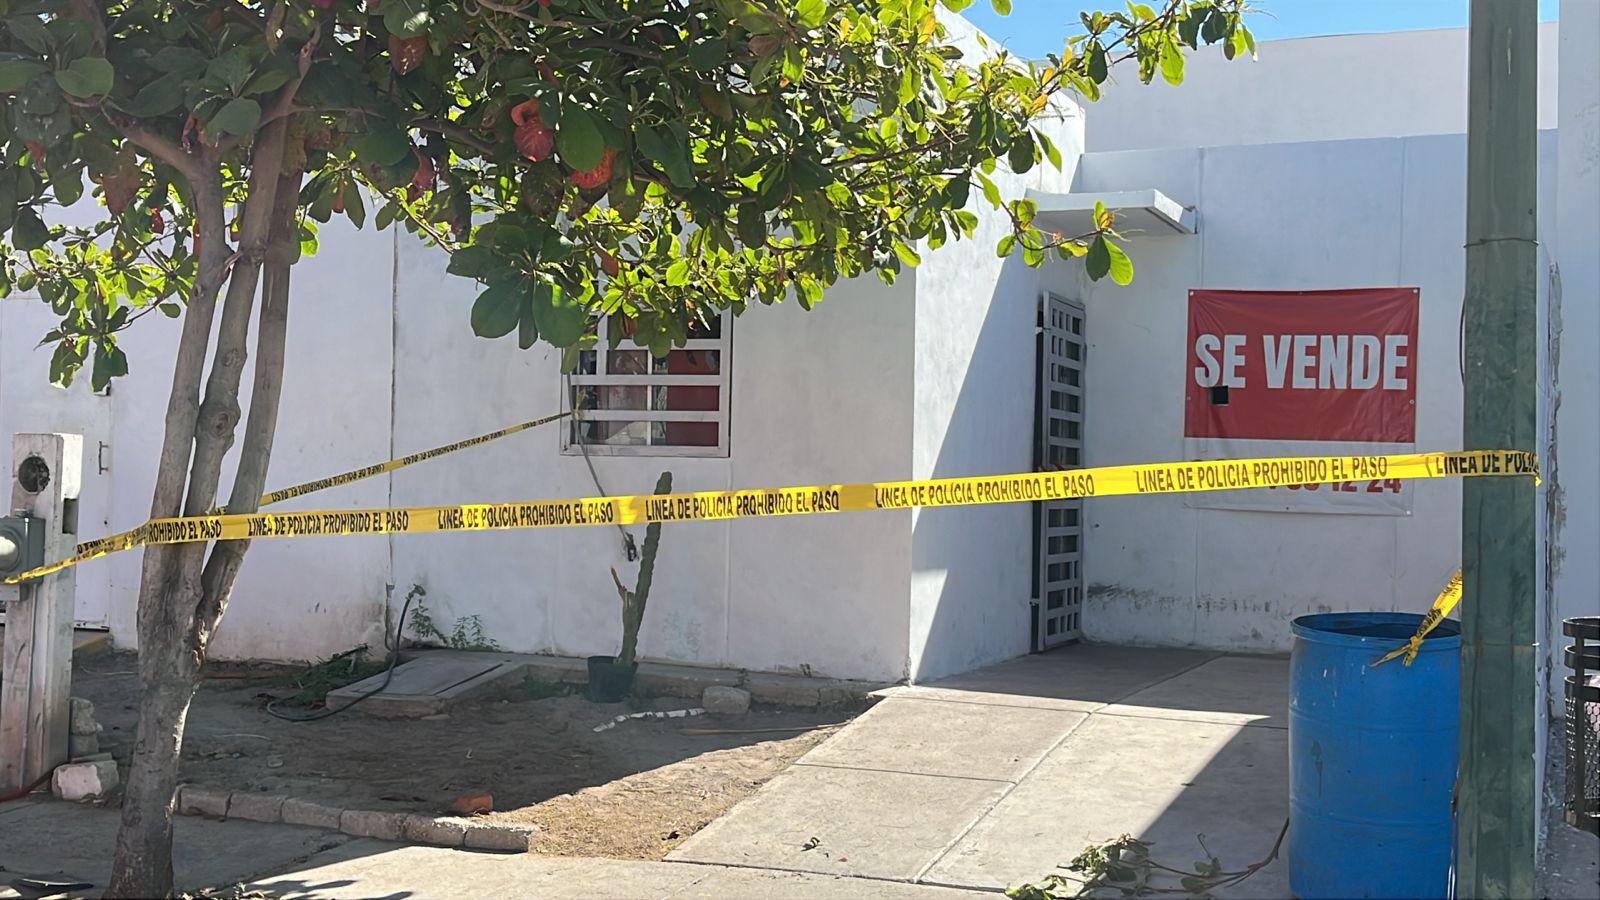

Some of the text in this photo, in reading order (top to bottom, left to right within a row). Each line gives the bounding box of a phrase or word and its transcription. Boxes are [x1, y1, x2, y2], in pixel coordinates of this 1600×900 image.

[1194, 334, 1409, 390] SE VENDE
[1135, 469, 1175, 492] LINEA
[1177, 467, 1195, 489] DE
[1197, 464, 1250, 488] POLICIA
[1253, 459, 1327, 485] PROHIBIDO
[1331, 458, 1348, 480] EL
[1352, 456, 1388, 478] PASO
[1436, 456, 1478, 474] LINEA
[1481, 454, 1500, 473] DE
[646, 490, 839, 520] LINEA DE POLICIA PROHIBIDO EL PASO
[875, 474, 1095, 508] LINEA DE POLICIA PROHIBIDO EL PASO
[188, 521, 199, 539] EL
[200, 519, 222, 539] PASO
[248, 511, 409, 536] LINEA DE POLICIA PROHIBIDO EL PASO
[438, 502, 613, 529] LINEA DE POLICIA PROHIBIDO EL PASO
